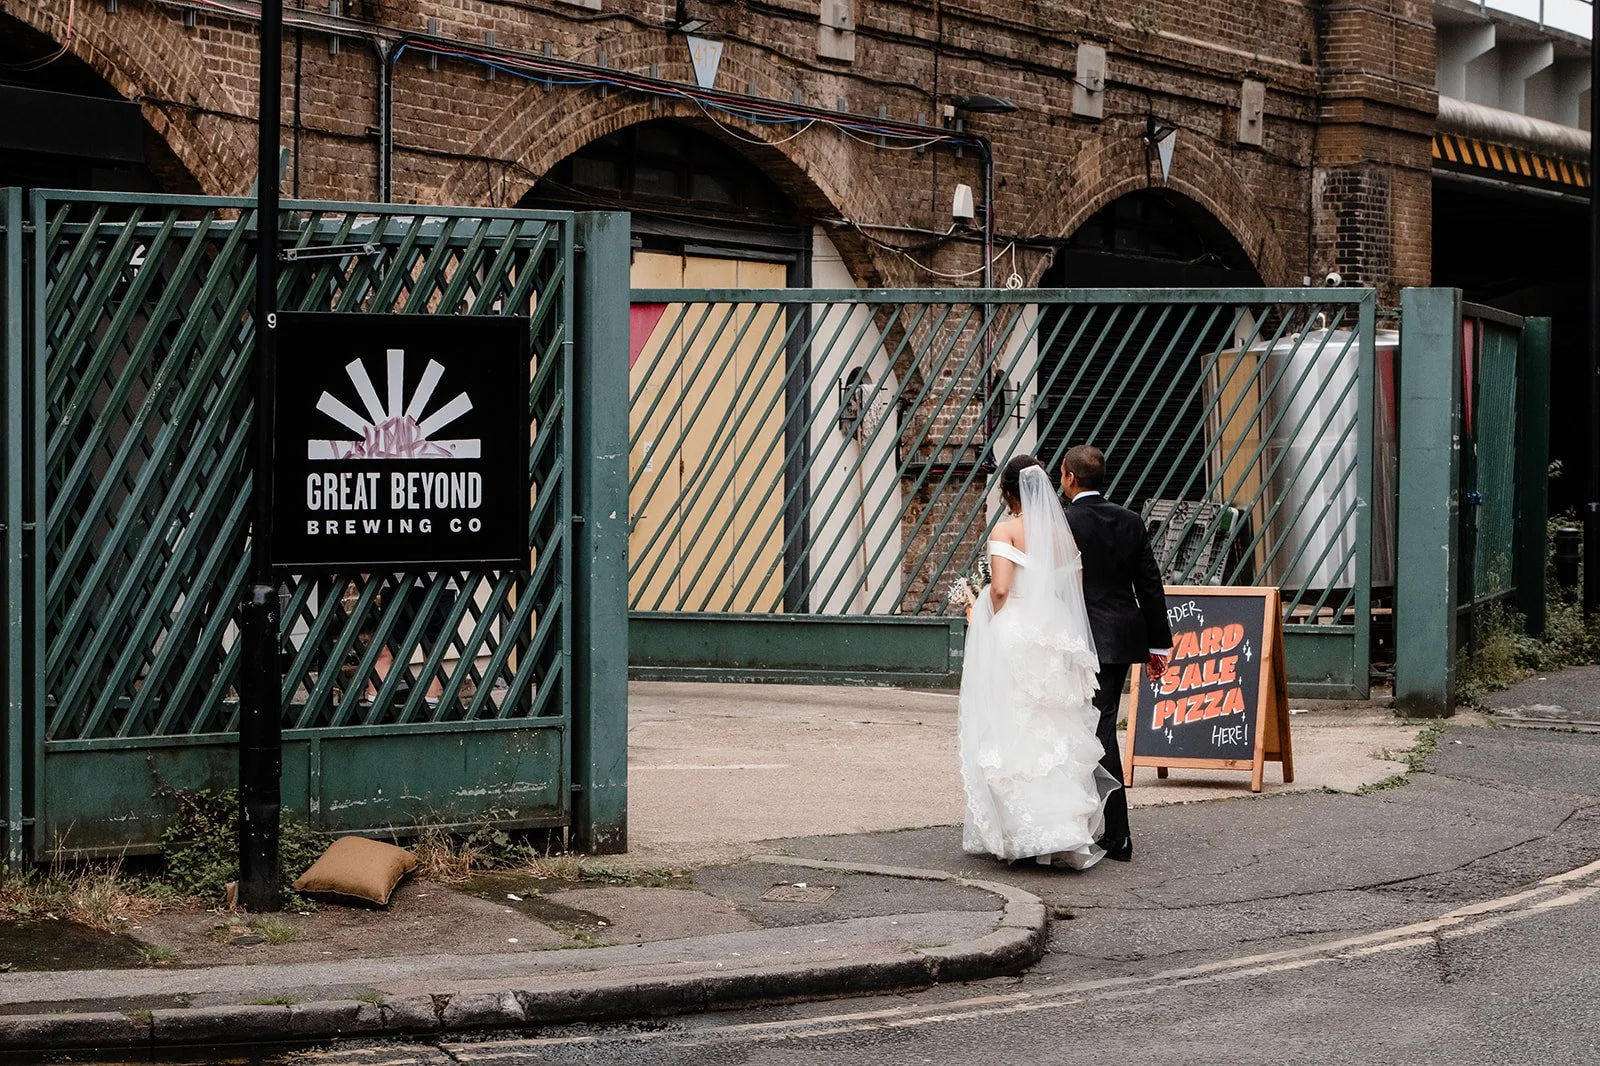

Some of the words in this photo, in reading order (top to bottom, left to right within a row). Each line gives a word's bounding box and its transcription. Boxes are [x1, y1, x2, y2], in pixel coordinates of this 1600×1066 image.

[692, 43, 717, 69] 417
[267, 313, 277, 329] 9
[306, 472, 381, 511] GREAT
[390, 471, 482, 510] BEYOND
[307, 518, 432, 535] BREWING
[449, 517, 482, 533] CO
[1166, 600, 1202, 628] RDER
[1160, 655, 1239, 695] SALE
[1151, 687, 1246, 730] PIZZA
[1211, 723, 1249, 748] HERE!
